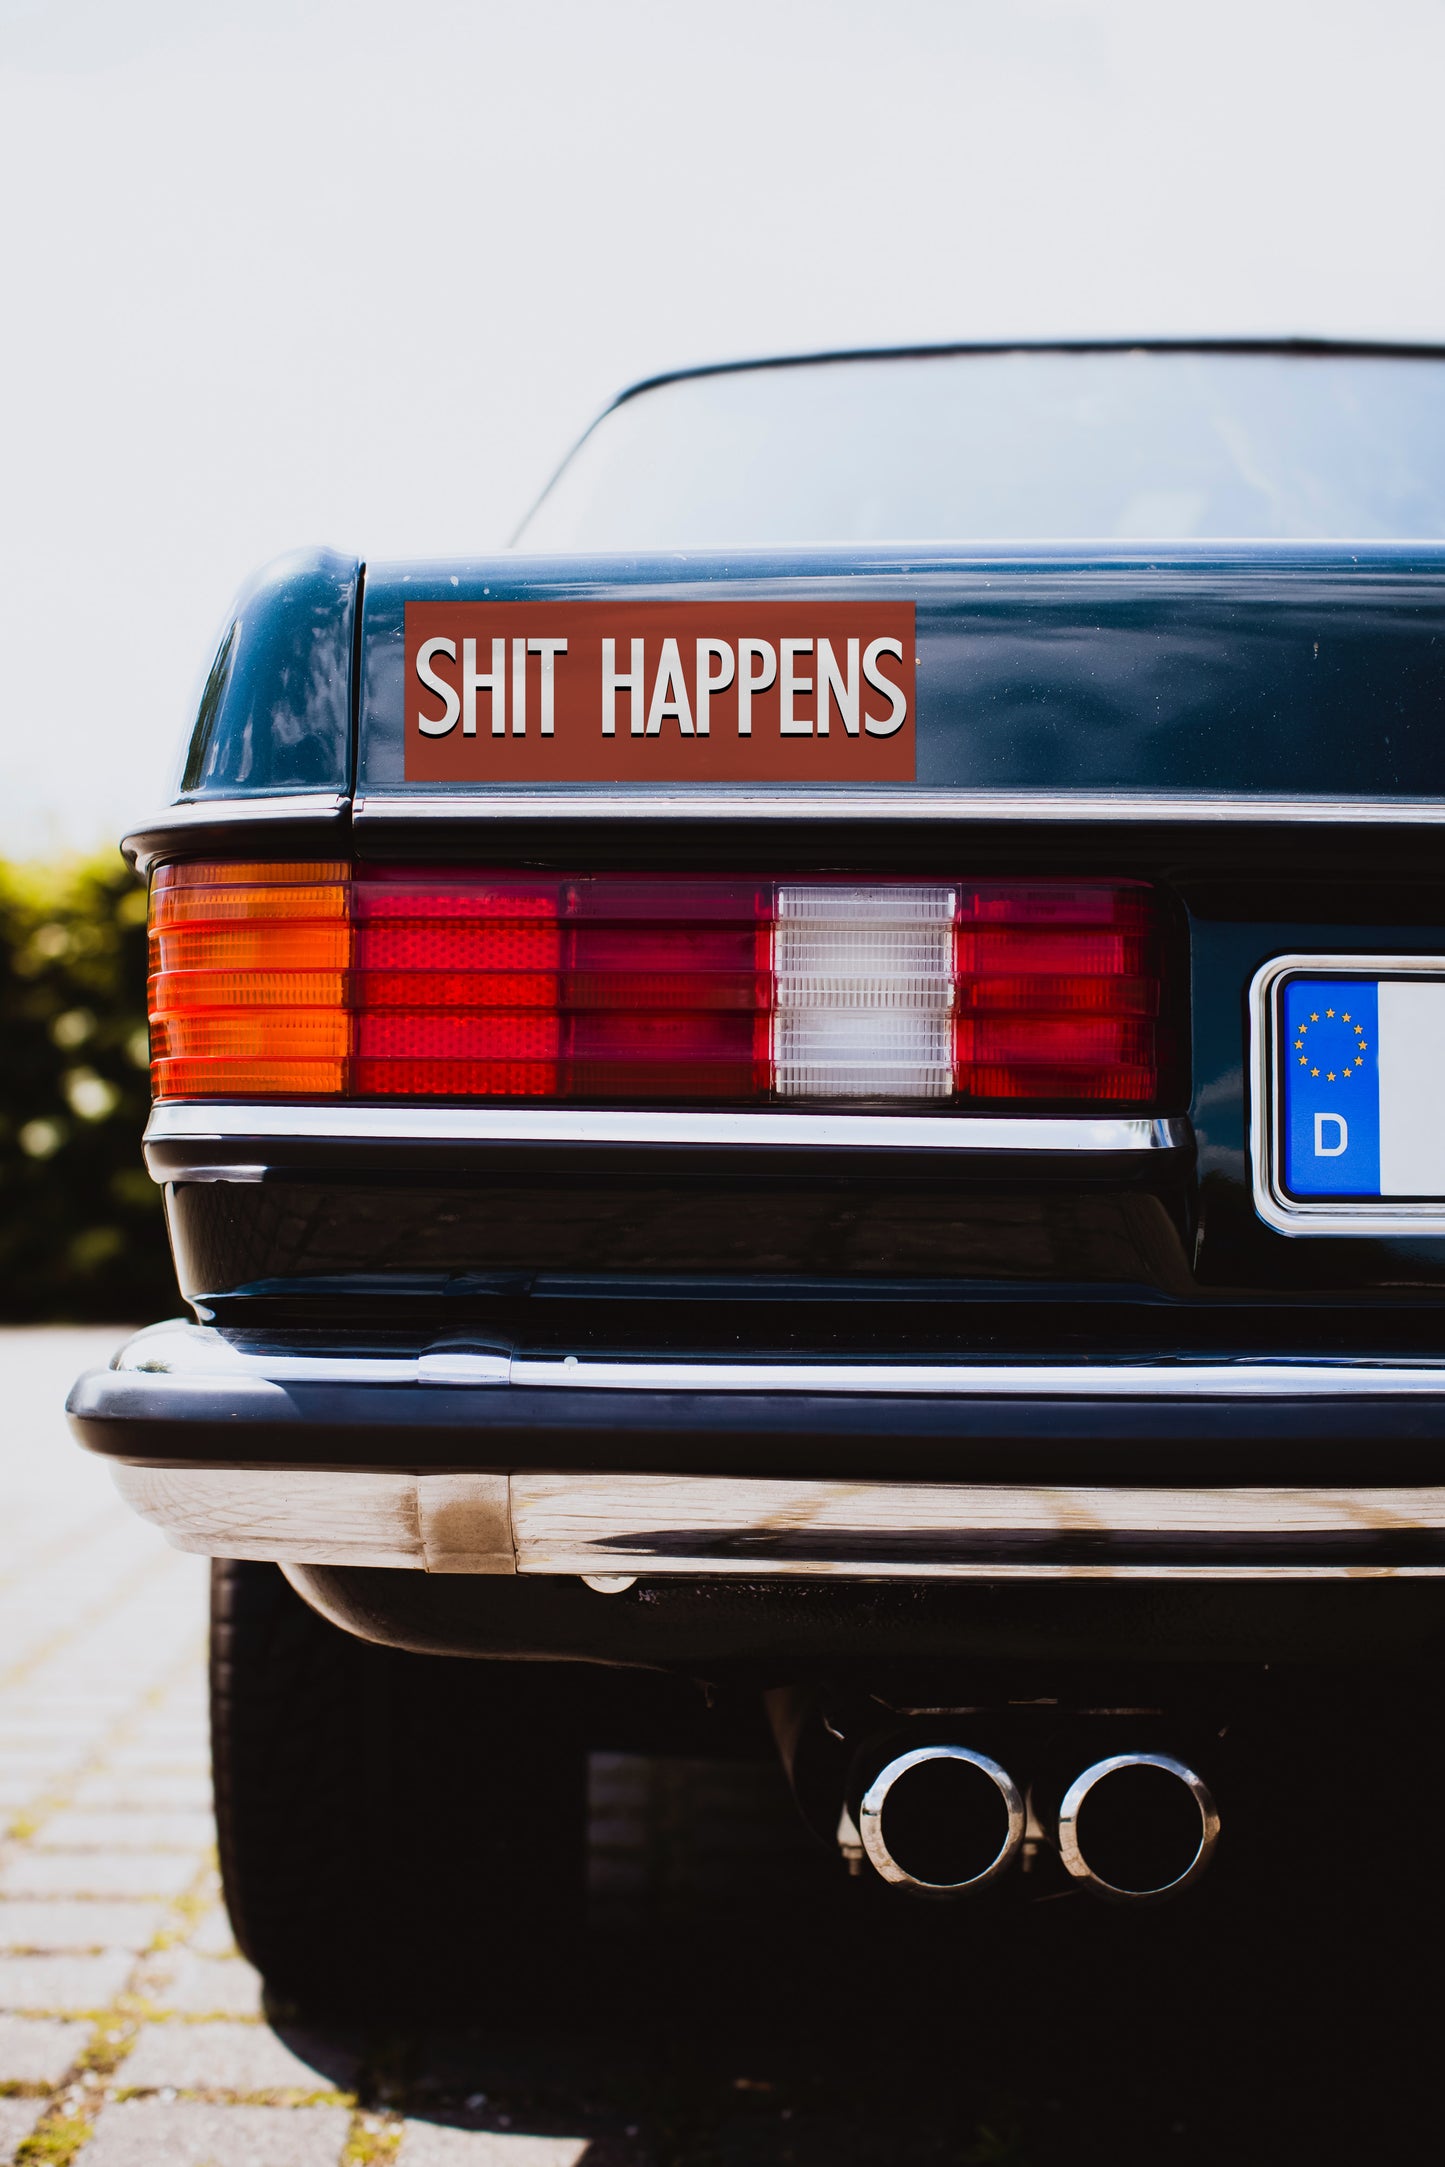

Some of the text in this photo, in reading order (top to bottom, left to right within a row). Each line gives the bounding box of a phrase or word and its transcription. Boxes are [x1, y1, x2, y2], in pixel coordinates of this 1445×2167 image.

[416, 637, 907, 738] SHIT HAPPENS
[1314, 1112, 1348, 1157] D
